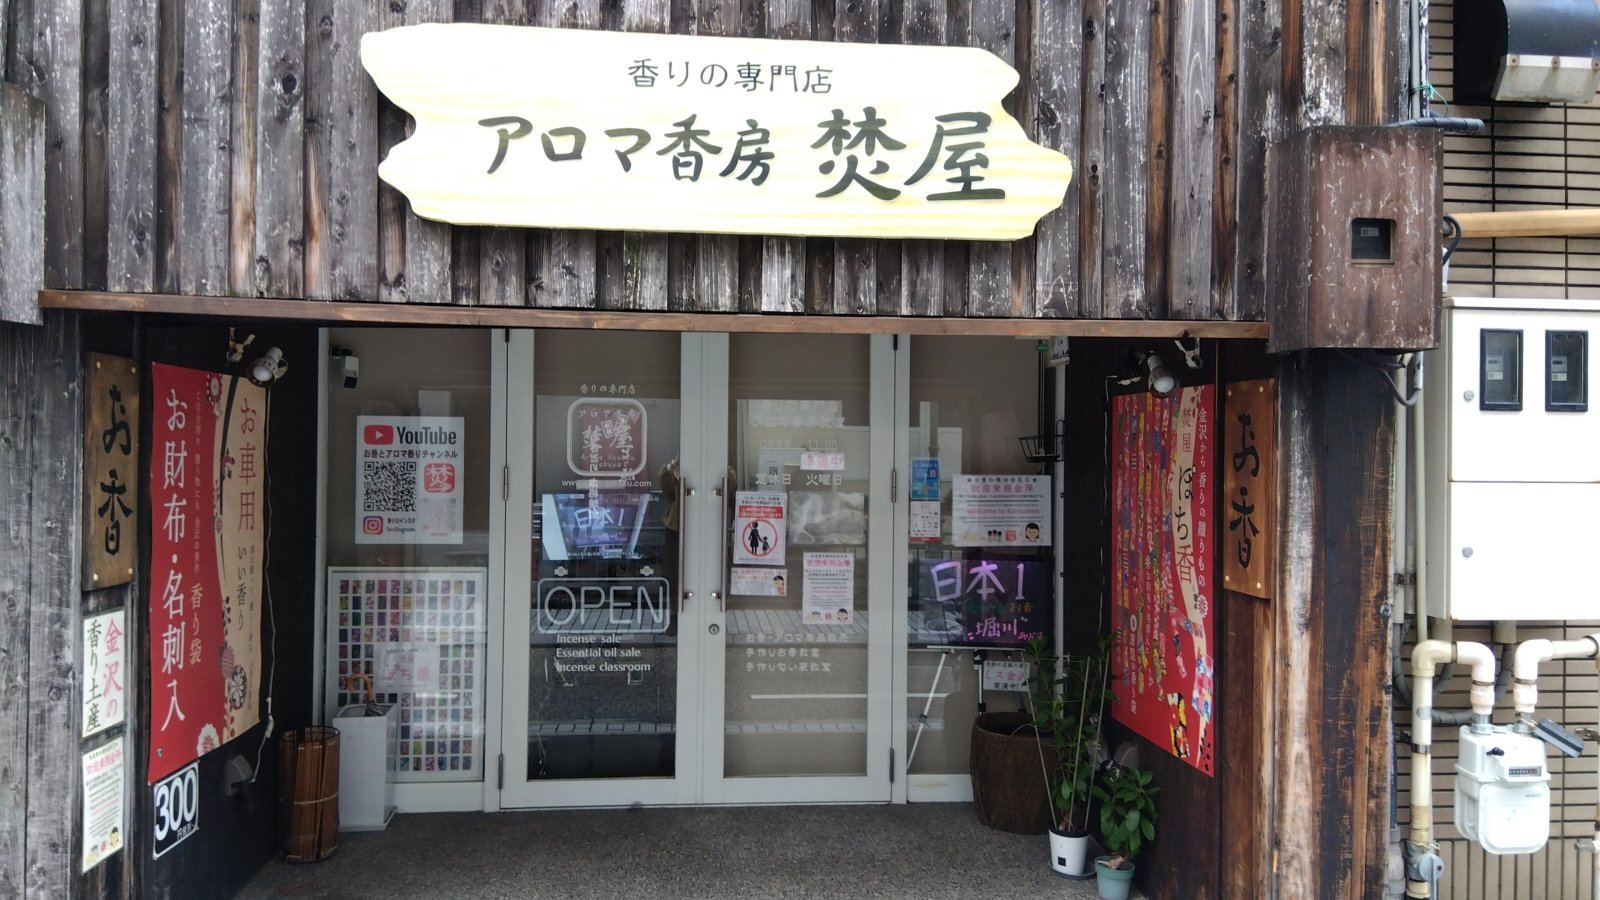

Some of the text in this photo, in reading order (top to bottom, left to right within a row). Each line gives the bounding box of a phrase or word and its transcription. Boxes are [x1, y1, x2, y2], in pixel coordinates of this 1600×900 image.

[628, 57, 834, 95] 香りの専門店
[478, 106, 1006, 201] アロマ香房 焚屋
[579, 383, 636, 394] 香りの専門店
[363, 449, 458, 459] お香とアロマ香りチャンネル
[396, 426, 457, 445] YouTube
[98, 384, 133, 555] お香
[238, 398, 257, 532] お車用
[806, 473, 842, 486] 火曜日
[1228, 412, 1260, 568] お香
[544, 585, 664, 626] OPEN
[556, 647, 641, 657] Essential oil sale
[557, 634, 622, 644] Incense sale
[86, 619, 102, 732] 香り土産
[103, 618, 123, 718] 金沢の
[556, 661, 651, 671] Incense classroom
[155, 768, 197, 841] 300
